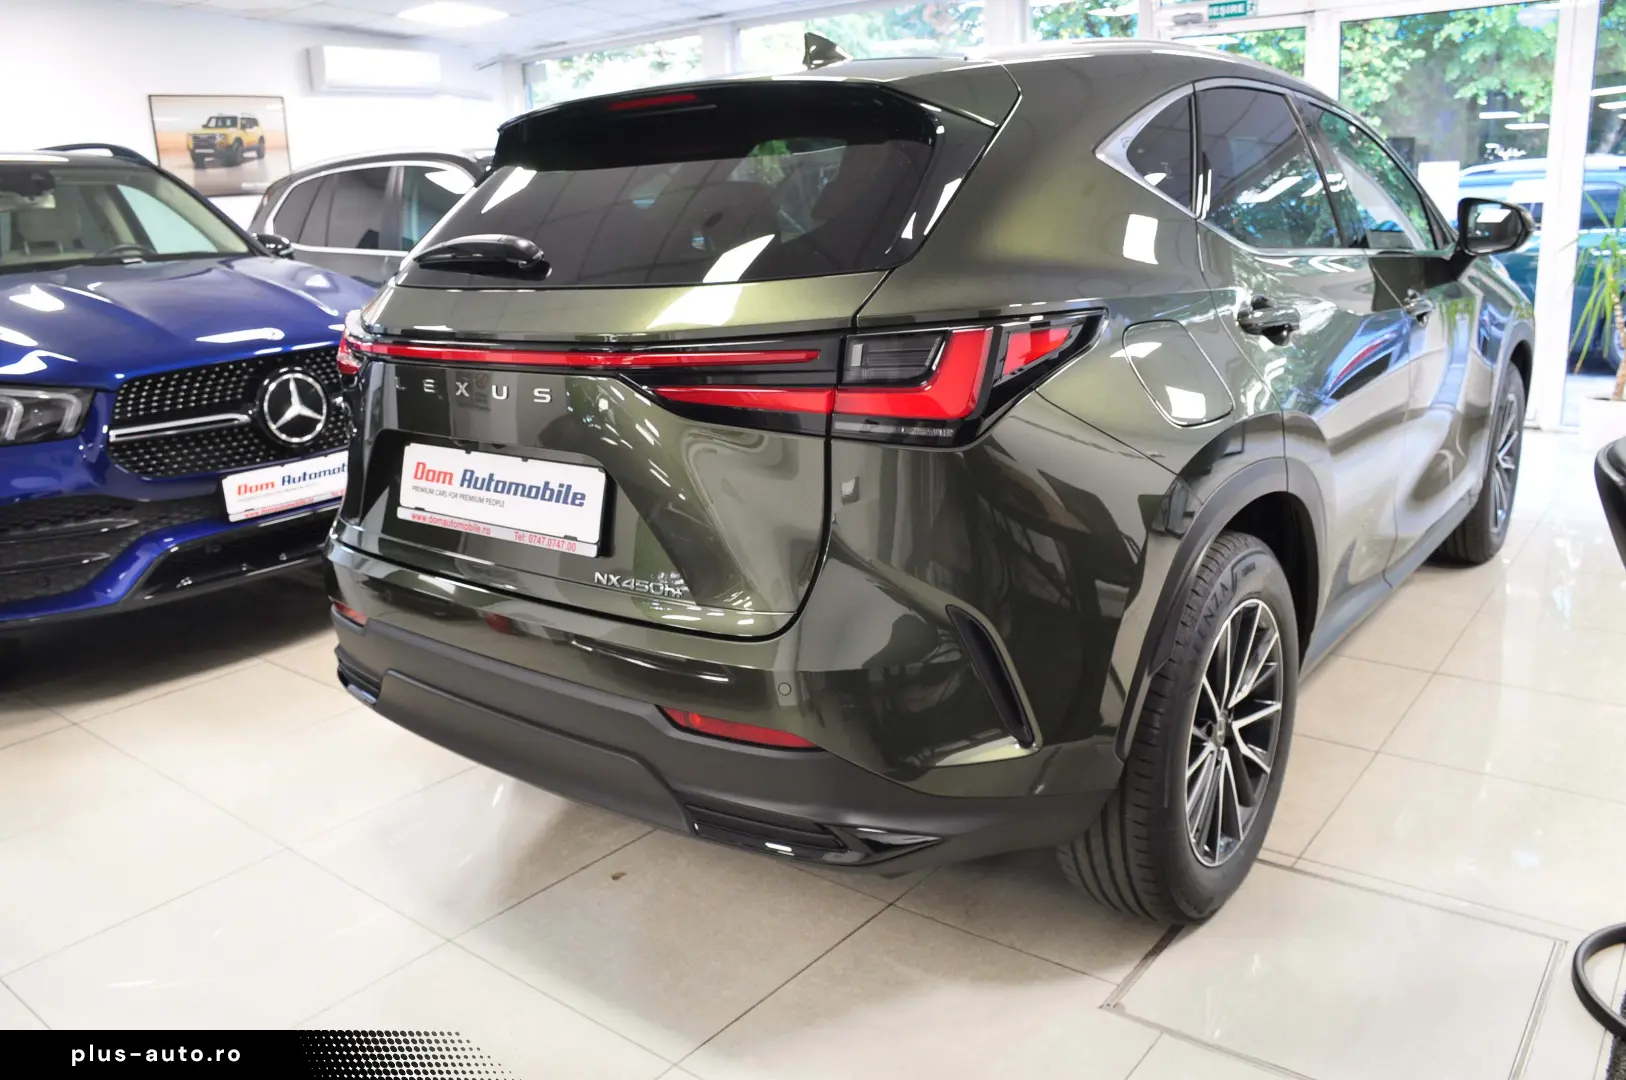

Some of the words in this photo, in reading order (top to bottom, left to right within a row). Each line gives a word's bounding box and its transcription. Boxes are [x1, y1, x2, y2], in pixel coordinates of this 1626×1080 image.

[396, 377, 552, 403] LEXUS
[237, 480, 275, 496] Dom
[412, 485, 435, 496] PREMIUM
[435, 489, 448, 498] CARS
[448, 491, 458, 500] FOR
[459, 493, 485, 504] PREMIUM
[485, 497, 505, 508] PEOPLE
[413, 461, 454, 486] Dom
[460, 469, 587, 508] Automobile
[411, 513, 491, 536] www.domautomobile.ro
[528, 534, 577, 552] 0747.0747.00
